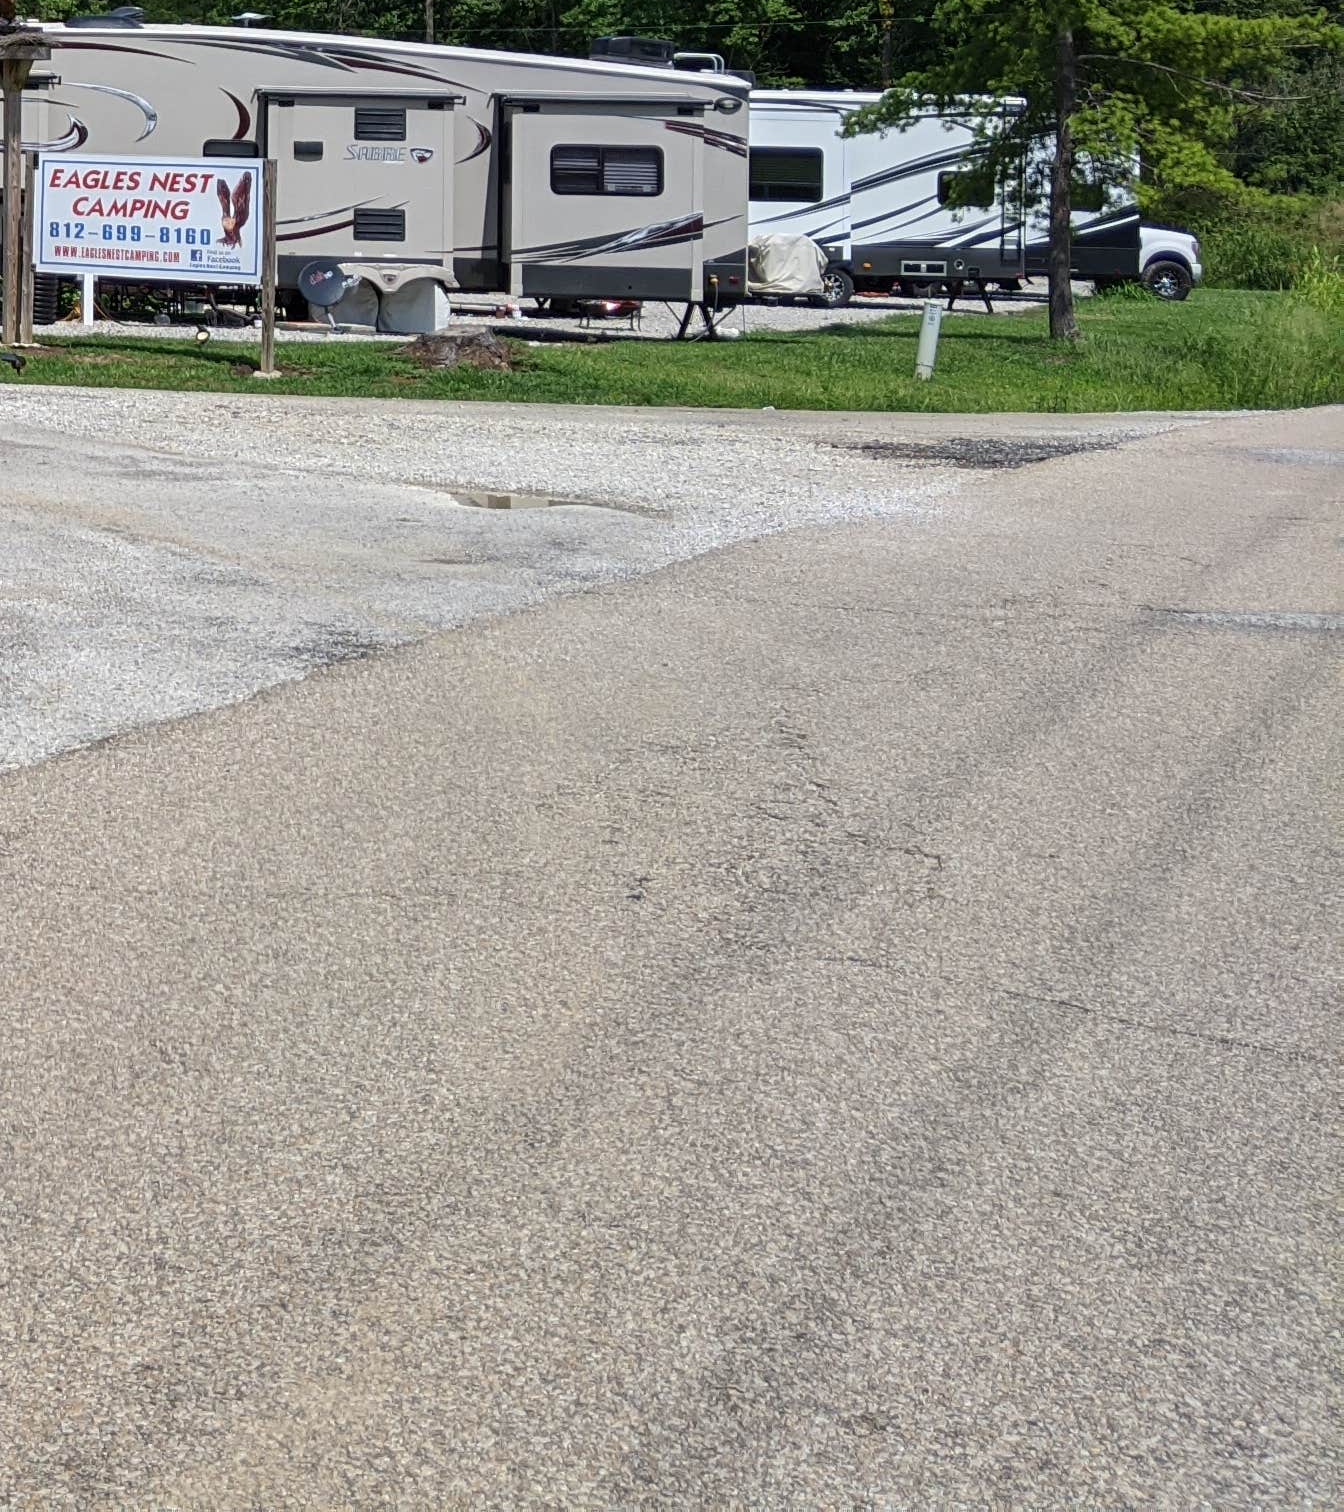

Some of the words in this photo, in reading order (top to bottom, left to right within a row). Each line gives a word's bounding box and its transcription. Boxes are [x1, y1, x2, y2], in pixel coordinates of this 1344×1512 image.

[49, 168, 141, 191] EAGLES
[149, 172, 214, 193] NEST
[72, 196, 190, 220] CAMPING
[49, 221, 211, 245] 812-699-8160
[54, 245, 180, 263] WWW.EAGLESNESTCAMPING.COM
[207, 255, 240, 264] Facebook
